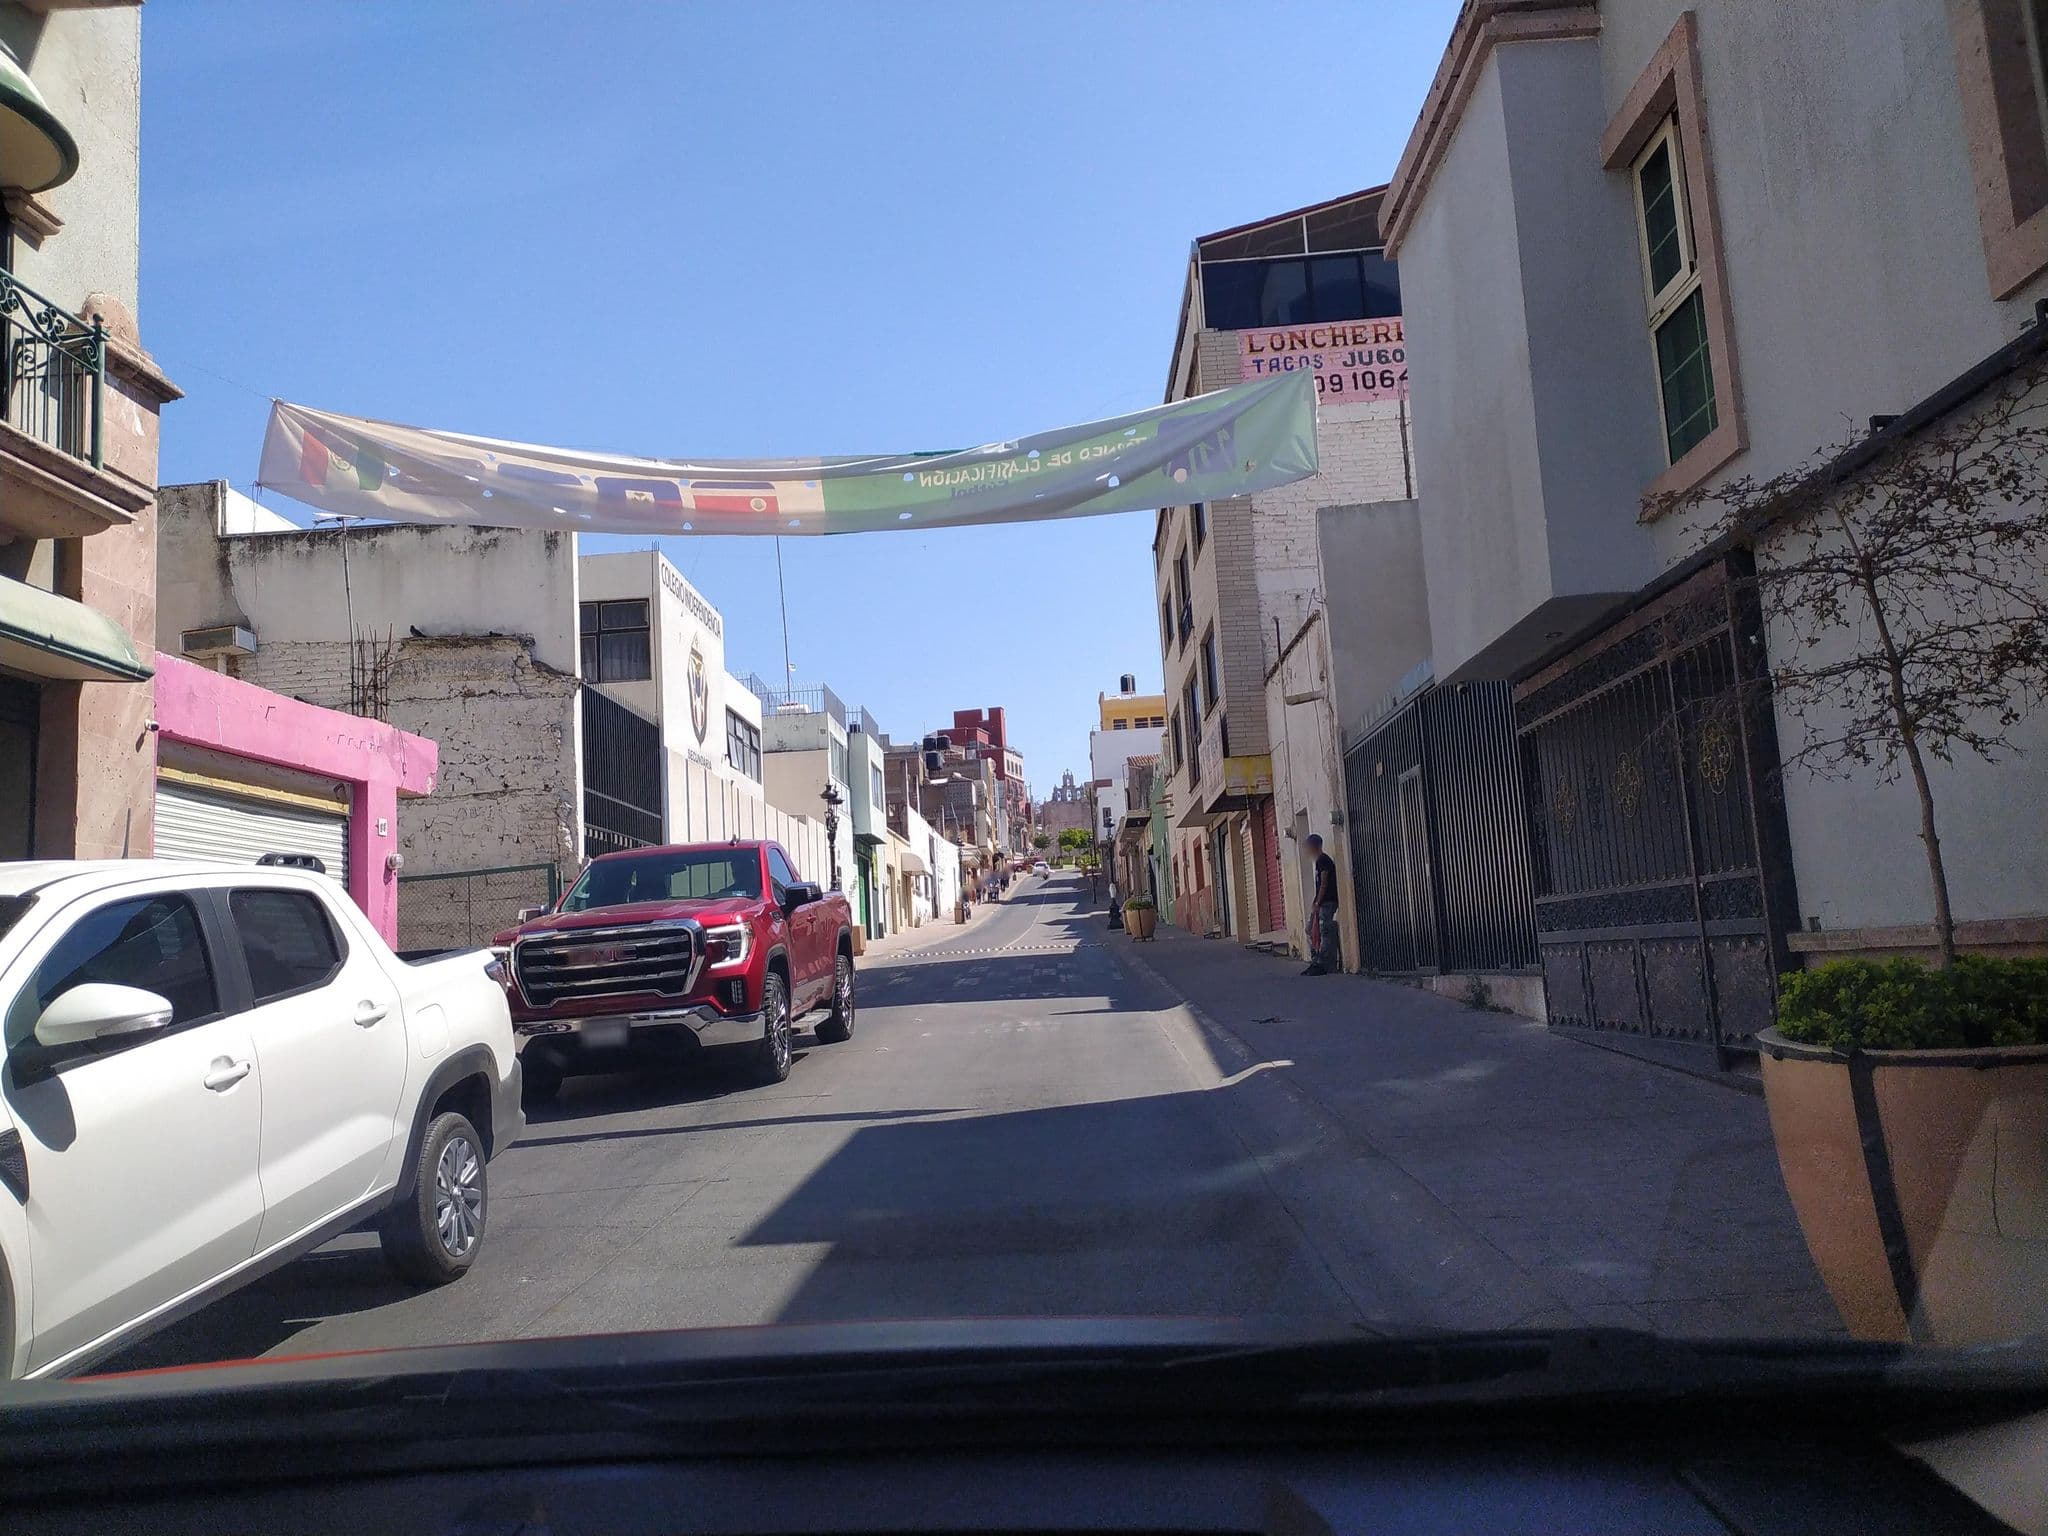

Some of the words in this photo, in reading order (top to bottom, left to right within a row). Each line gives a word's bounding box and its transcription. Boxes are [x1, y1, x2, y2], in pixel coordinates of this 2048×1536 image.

[1252, 354, 1324, 373] TACOS
[661, 563, 685, 604] COLEGIO
[684, 586, 722, 641] INDEPENDENCIA
